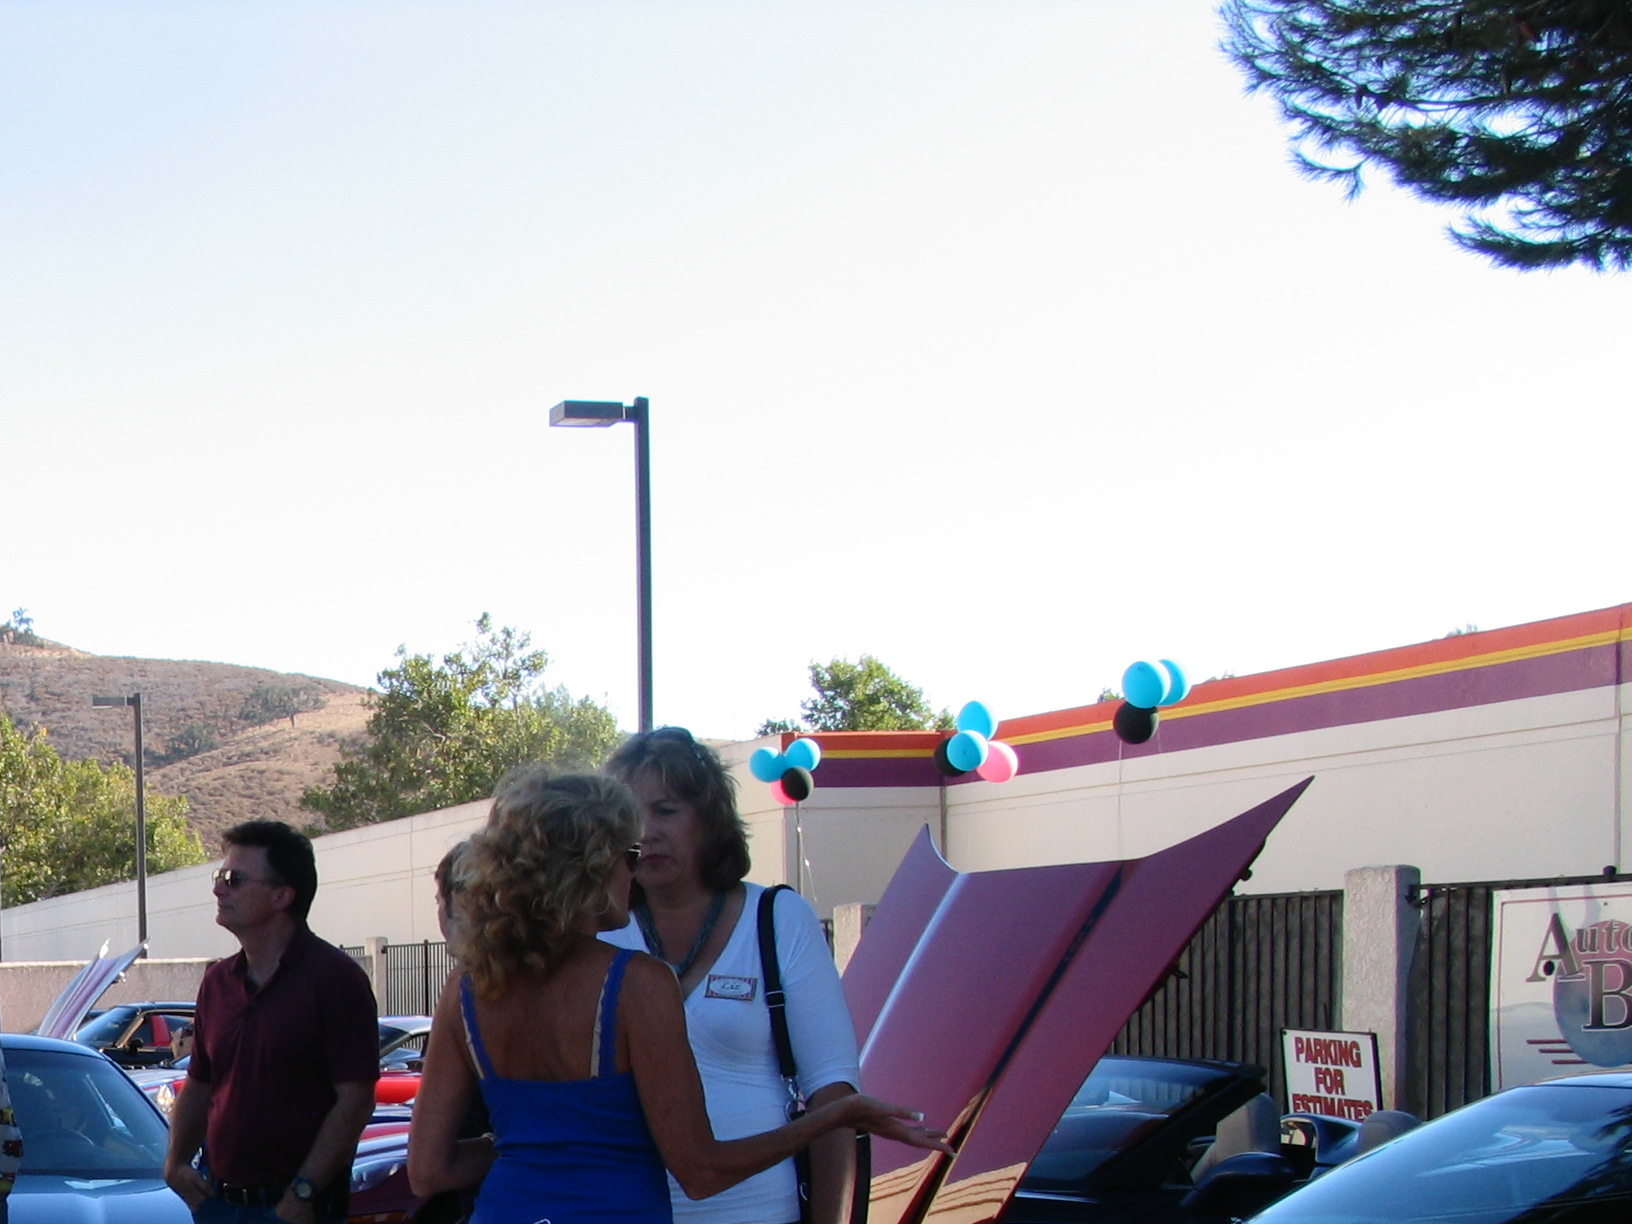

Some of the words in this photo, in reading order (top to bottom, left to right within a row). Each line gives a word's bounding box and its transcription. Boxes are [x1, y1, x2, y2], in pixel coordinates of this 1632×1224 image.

[1294, 1036, 1362, 1068] PARKING
[1314, 1066, 1346, 1096] FOR
[1292, 1093, 1374, 1122] ESTIMATES
